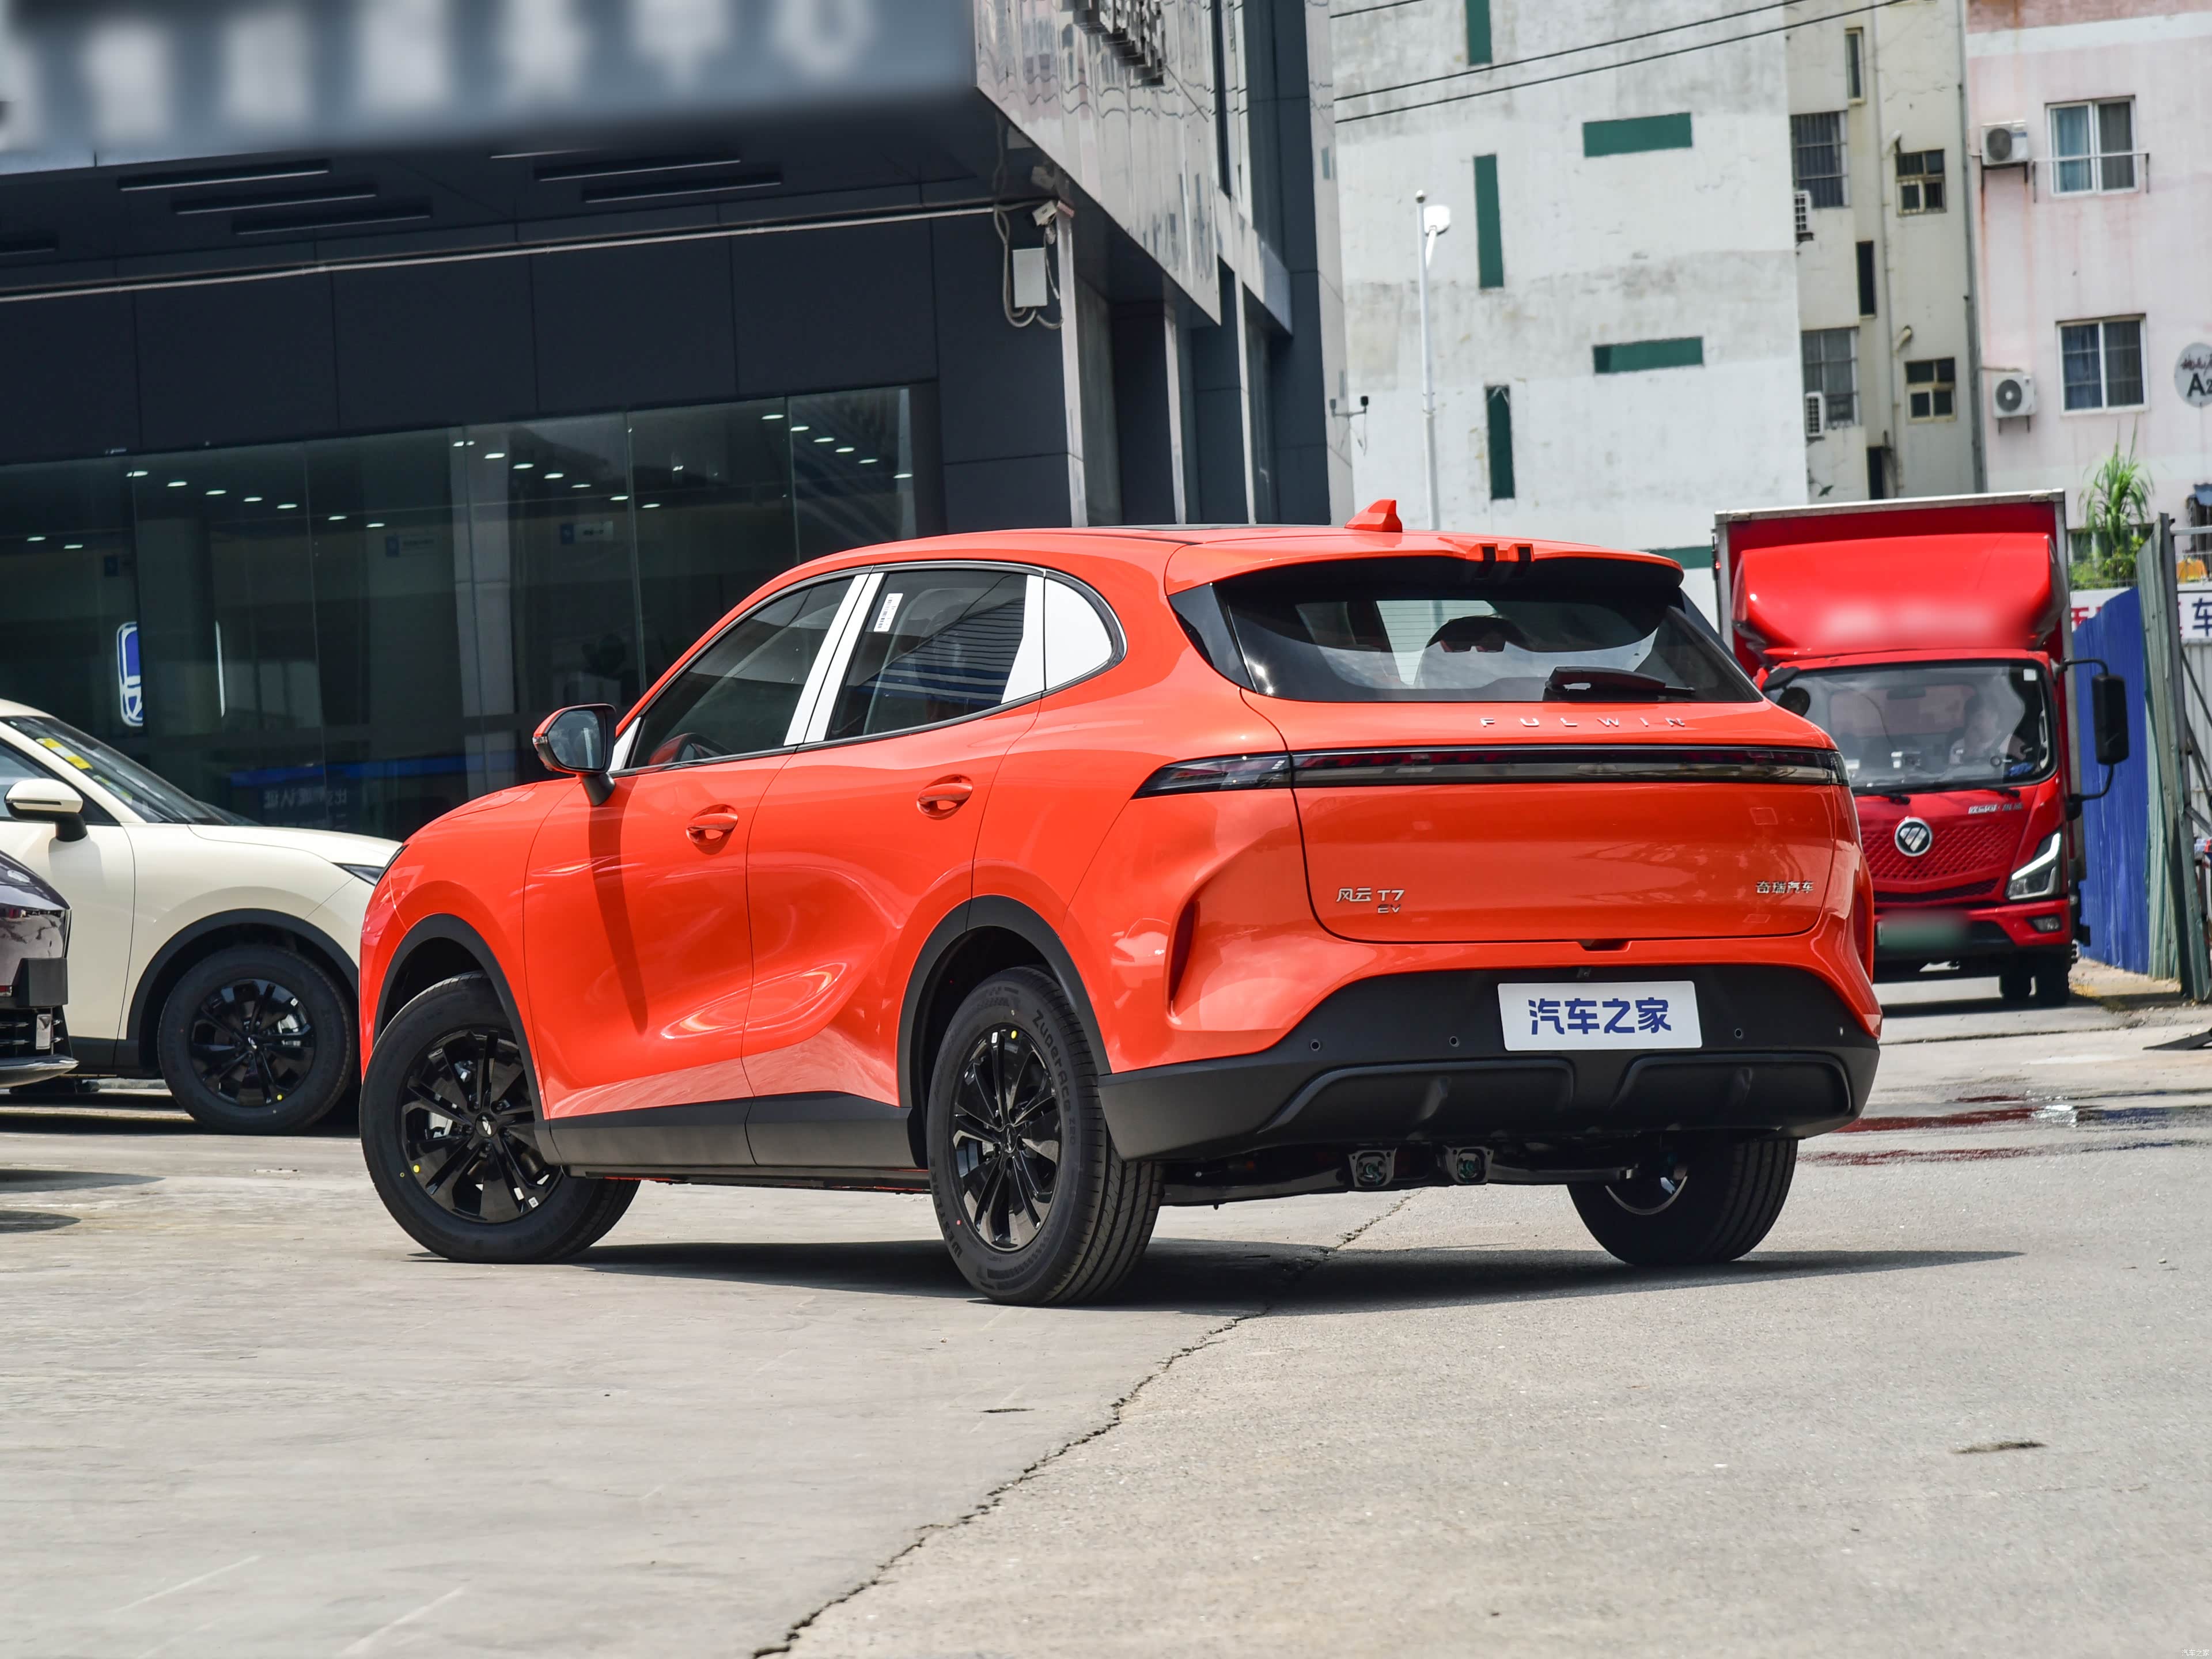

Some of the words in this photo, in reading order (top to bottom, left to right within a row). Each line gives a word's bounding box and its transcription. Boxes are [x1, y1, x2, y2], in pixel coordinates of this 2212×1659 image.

[1480, 717, 1685, 727] FULWIN
[1756, 881, 1814, 894] 奇瑞汽车
[1336, 887, 1372, 902] 风云
[1377, 889, 1405, 902] T7
[1377, 904, 1401, 914] EV
[1528, 997, 1672, 1035] 汽车之家
